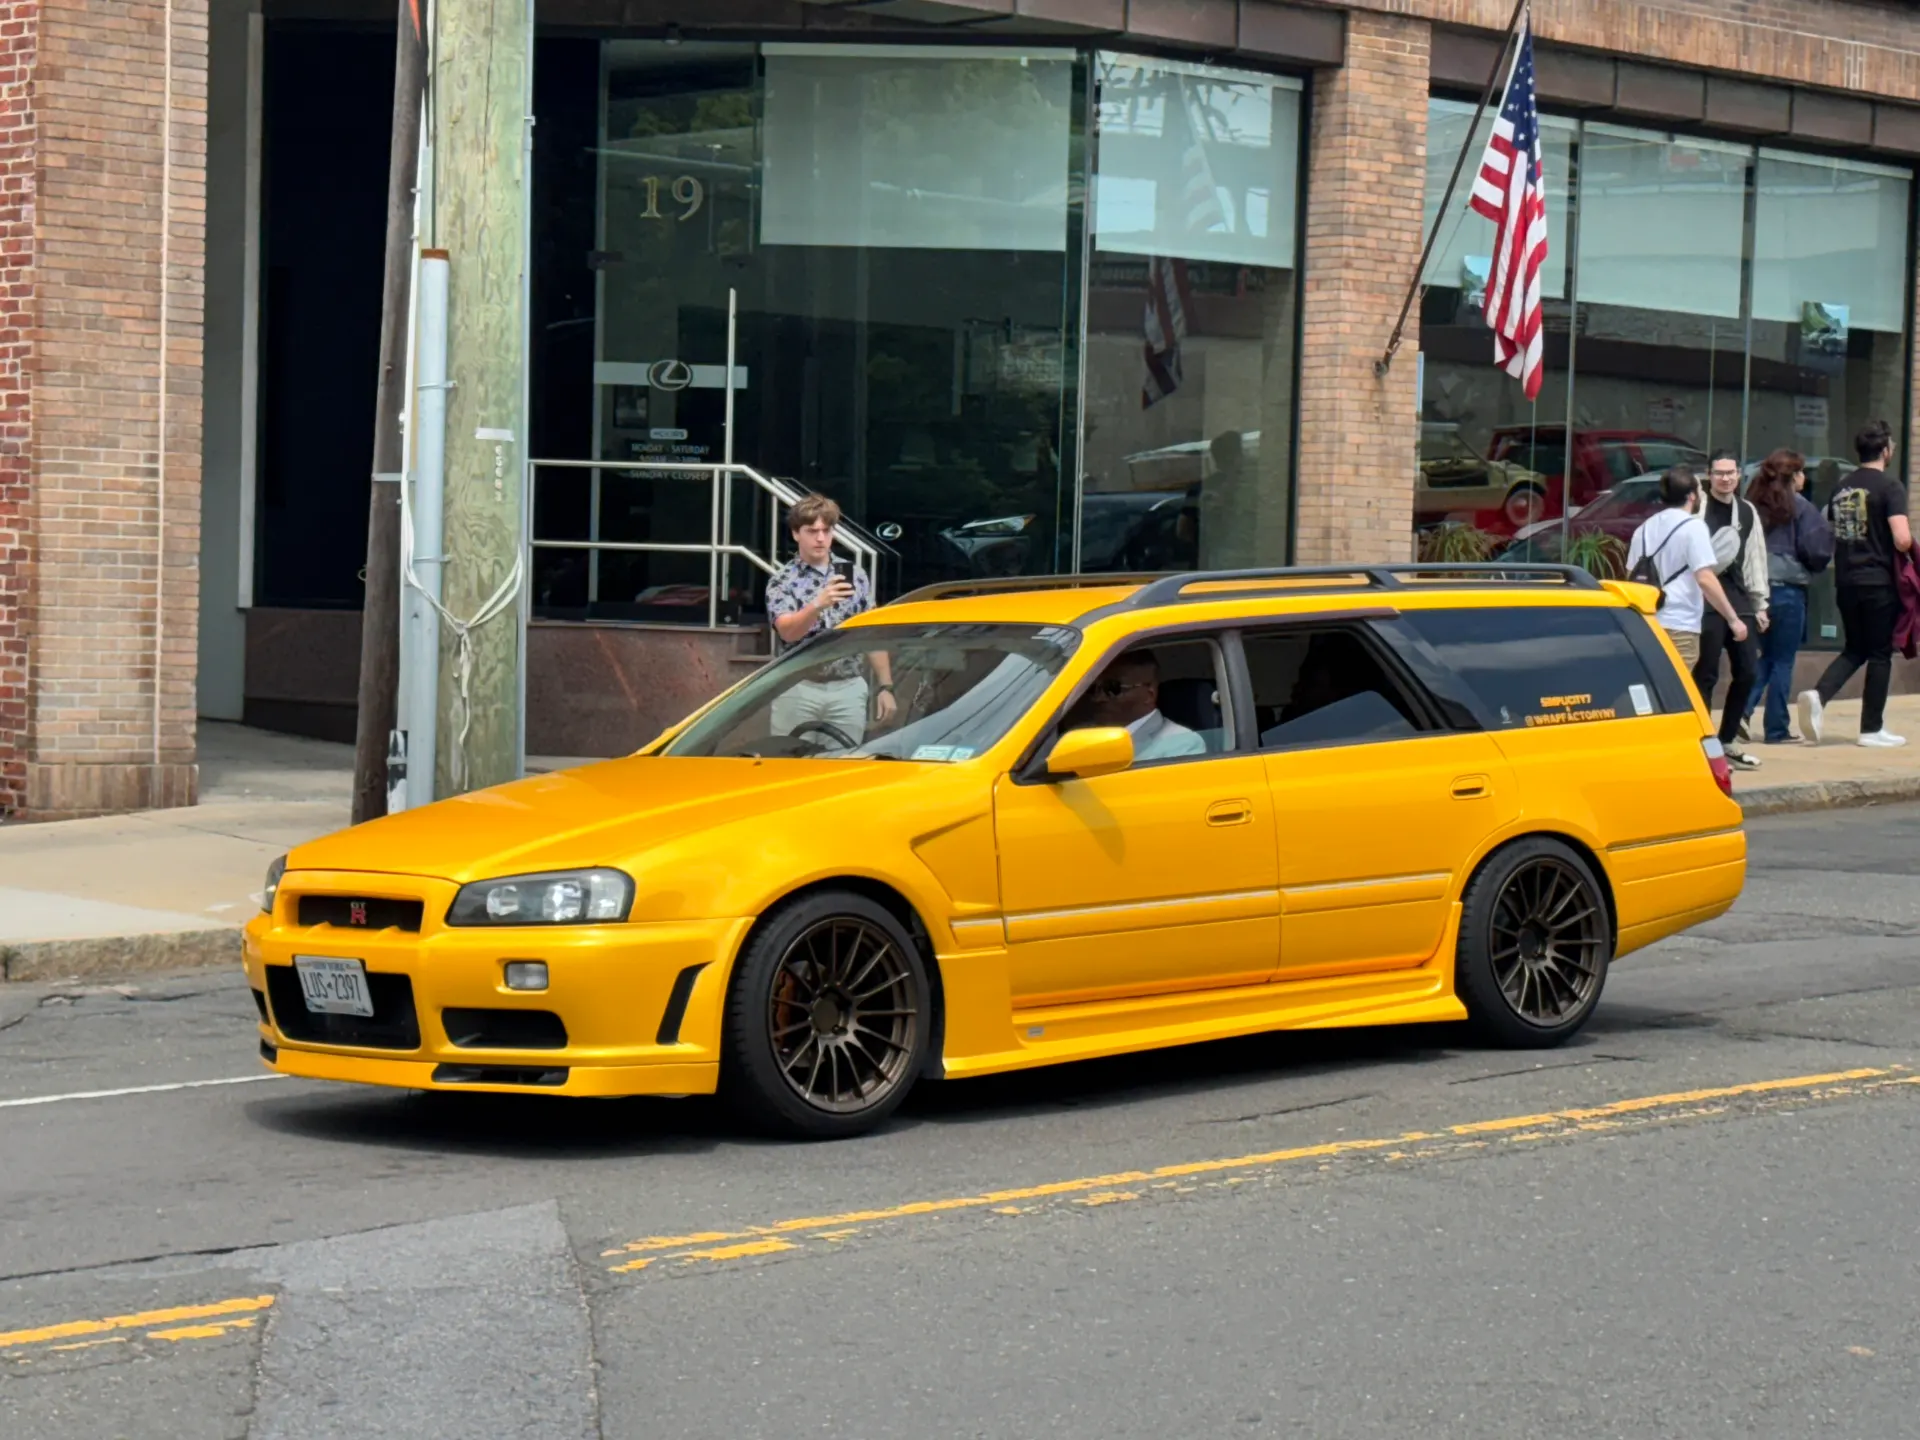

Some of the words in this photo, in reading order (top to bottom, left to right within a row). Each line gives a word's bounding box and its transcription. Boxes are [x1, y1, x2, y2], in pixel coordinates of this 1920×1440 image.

[639, 175, 704, 221] 19
[630, 470, 669, 479] SUNDAY
[350, 908, 367, 925] R
